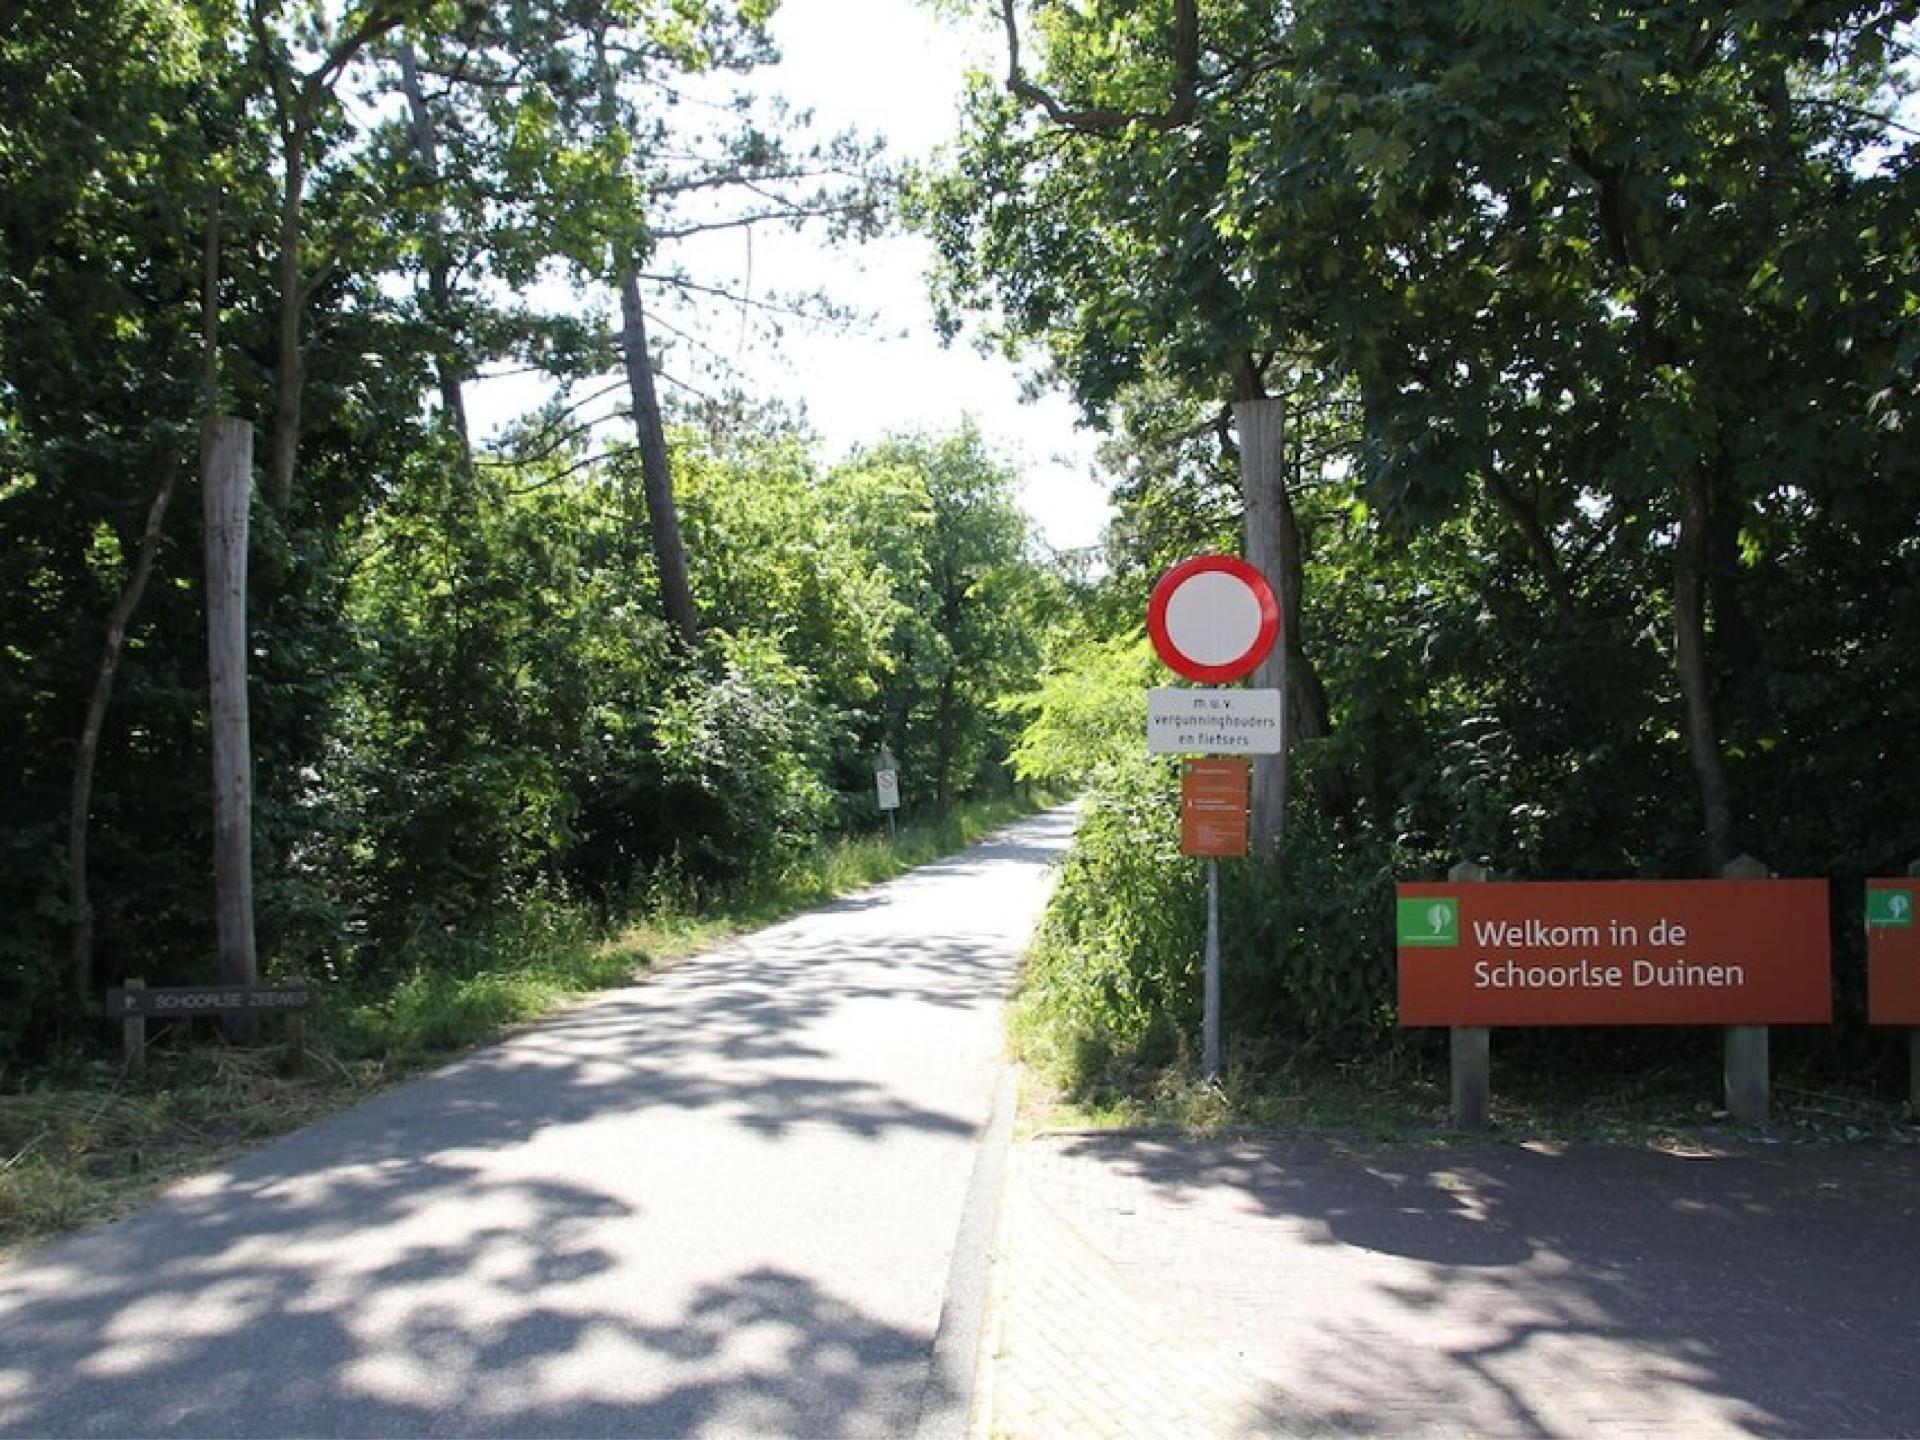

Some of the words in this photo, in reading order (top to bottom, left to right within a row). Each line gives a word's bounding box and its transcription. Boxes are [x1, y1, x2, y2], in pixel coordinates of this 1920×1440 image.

[1154, 714, 1277, 730] vergunninghouders
[1178, 734, 1194, 745] en
[1198, 732, 1249, 745] fietsers
[1473, 919, 1599, 947] Welkom
[1609, 919, 1638, 946] in
[1649, 918, 1686, 946] de
[1474, 959, 1622, 988] Schoorlse
[1632, 959, 1745, 987] Duinen
[153, 992, 242, 1009] SCHOORLSE
